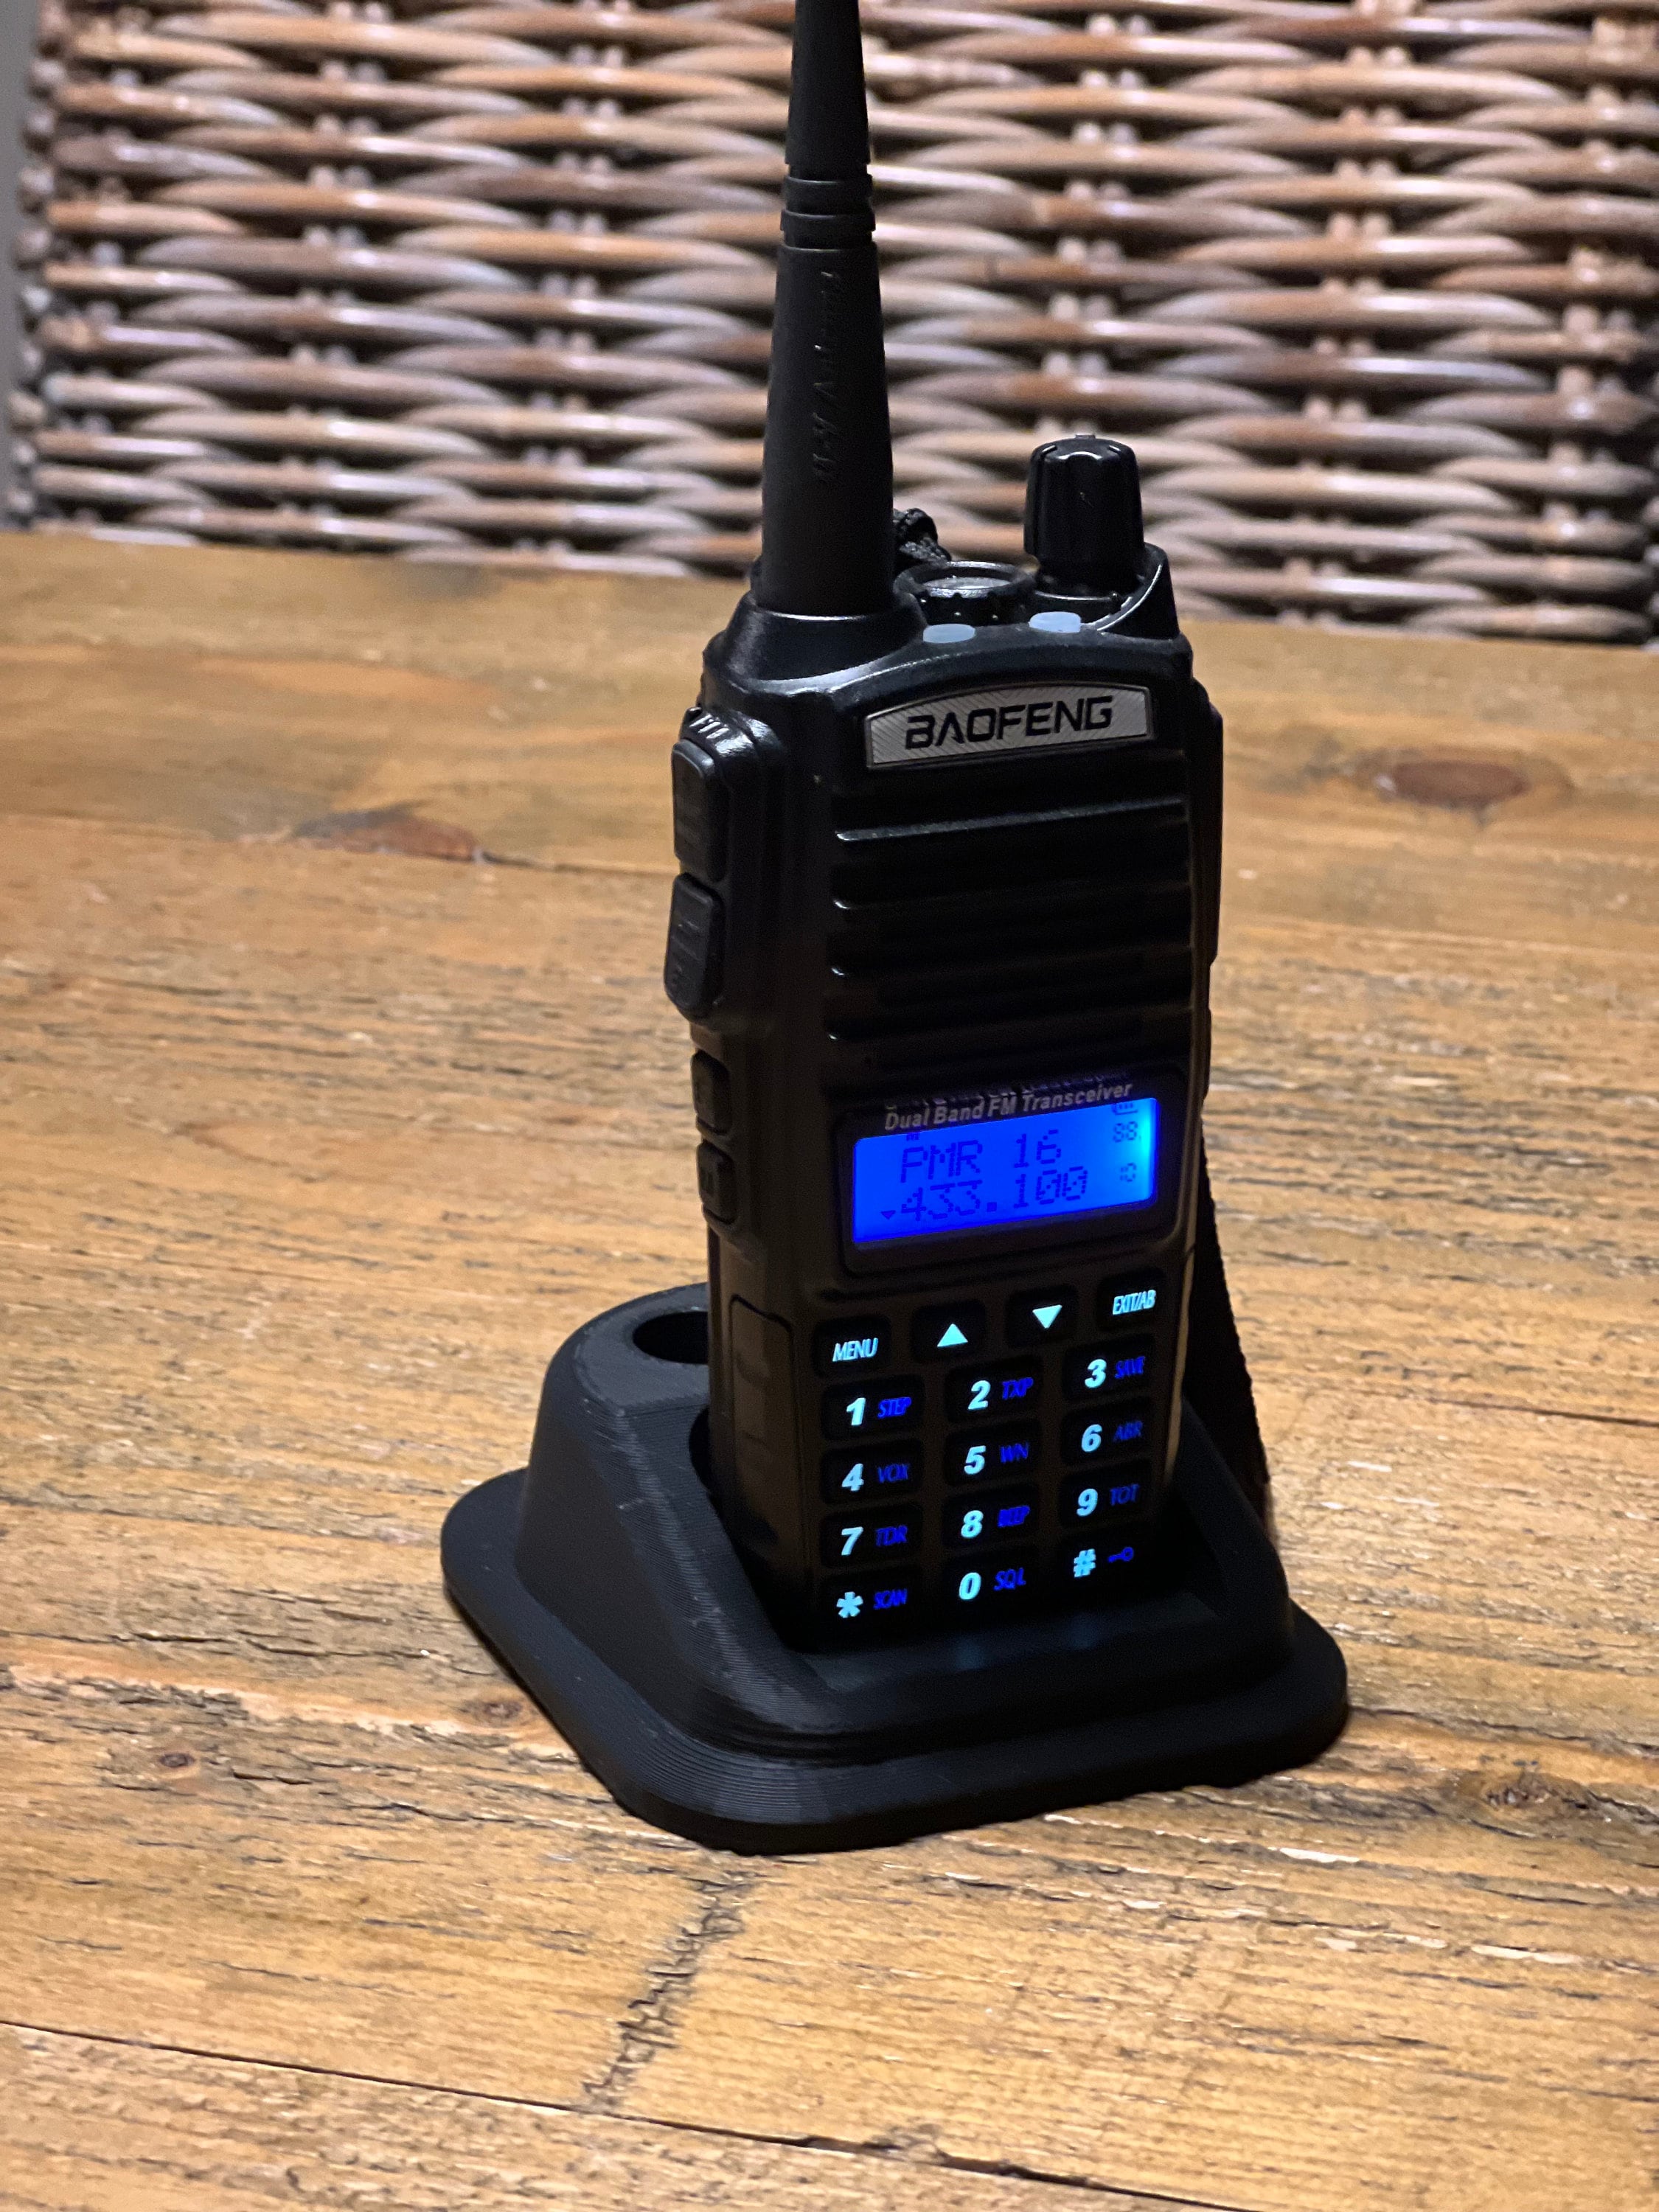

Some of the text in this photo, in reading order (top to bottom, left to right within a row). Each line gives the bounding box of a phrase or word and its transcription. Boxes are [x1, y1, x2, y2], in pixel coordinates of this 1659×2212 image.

[905, 695, 1113, 750] BAOFENG
[885, 1113, 928, 1130] Dual
[933, 1100, 984, 1125] Band
[1022, 1083, 1132, 1111] Transceiver
[900, 1129, 1062, 1183] PMR 16
[901, 1166, 1088, 1222] 433.100
[1113, 1290, 1156, 1315] EXIT/AB
[832, 1338, 878, 1362] MENU
[1085, 1357, 1144, 1388] 3 SAVE
[968, 1377, 1033, 1410] 2 TXP
[846, 1397, 911, 1425] 1 STEP
[1082, 1425, 1102, 1452] 6
[964, 1445, 986, 1475] 5
[842, 1464, 908, 1491] 4 VOX
[1077, 1484, 1138, 1516] 9 TOT
[961, 1510, 984, 1538] 8
[841, 1526, 908, 1555] 7 TDR
[959, 1568, 1026, 1600] 0 SQL
[874, 1590, 907, 1609] SCAN
